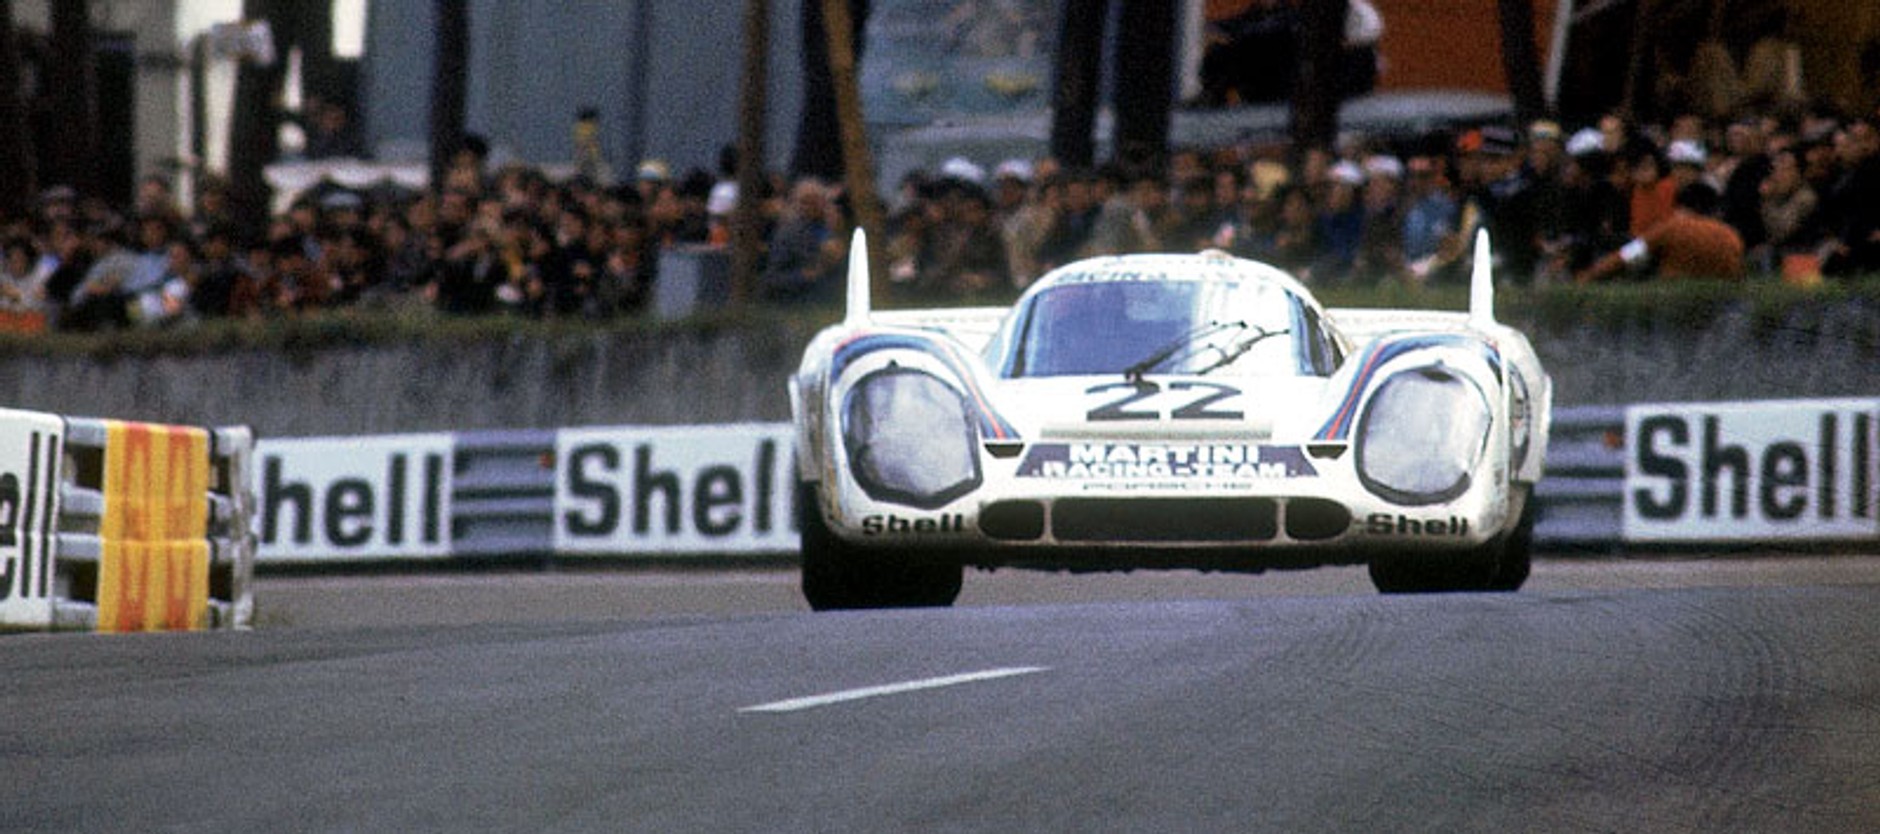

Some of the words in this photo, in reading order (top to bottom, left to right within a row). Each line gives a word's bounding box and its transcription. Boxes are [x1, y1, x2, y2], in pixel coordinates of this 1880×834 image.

[1085, 382, 1244, 421] 22
[1068, 444, 1259, 463] MARTINI
[1633, 412, 1870, 519] Shell
[262, 453, 443, 546] hell
[862, 512, 963, 536] Shell
[1367, 512, 1468, 536] Shell
